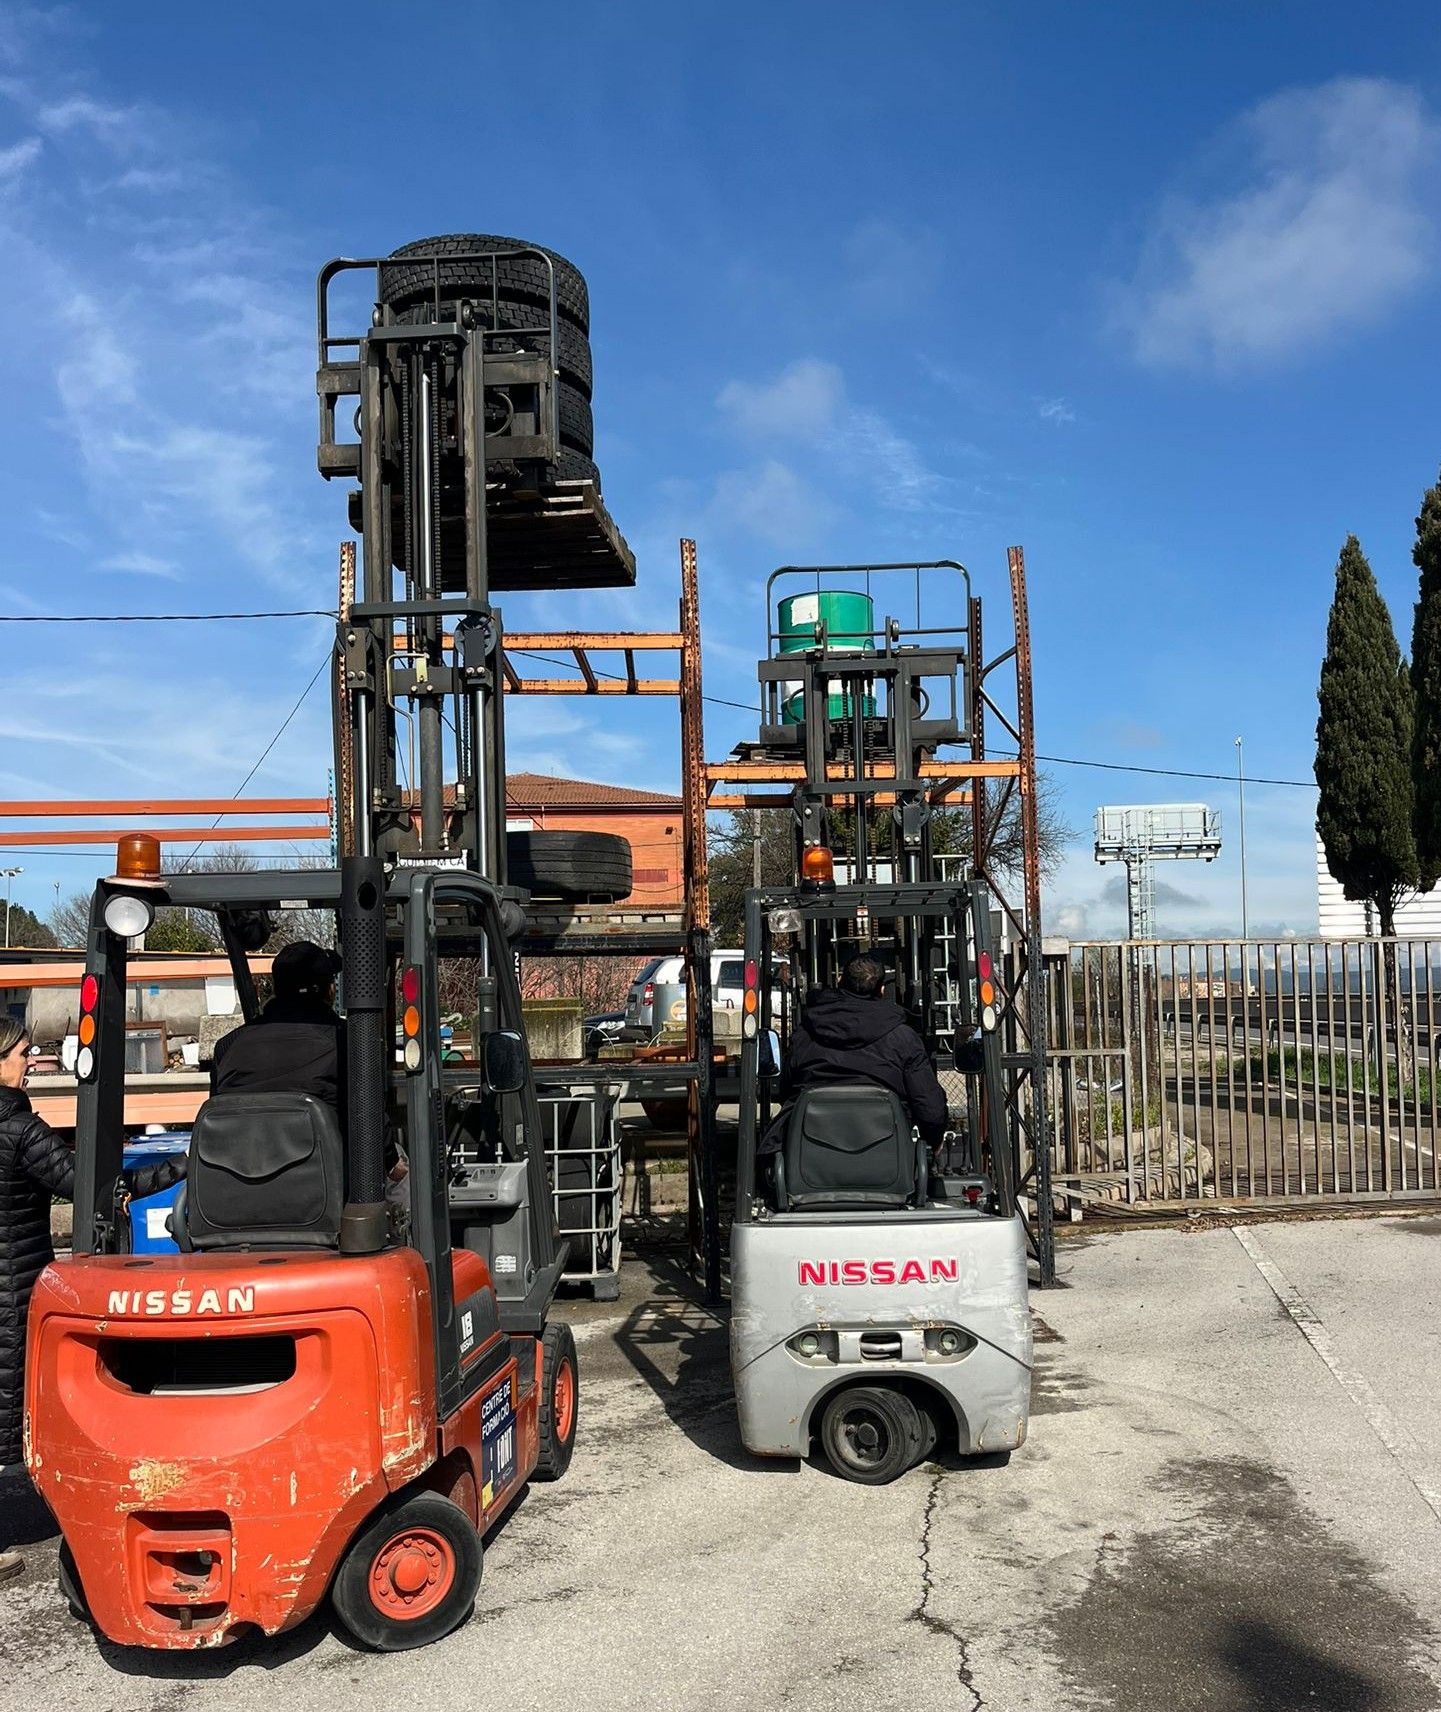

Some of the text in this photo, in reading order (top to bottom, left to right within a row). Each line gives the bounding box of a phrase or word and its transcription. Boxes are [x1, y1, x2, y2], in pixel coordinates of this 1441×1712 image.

[799, 1257, 959, 1285] NISSAN
[108, 1287, 255, 1315] NISSAN
[482, 1380, 511, 1419] CENTRE DE
